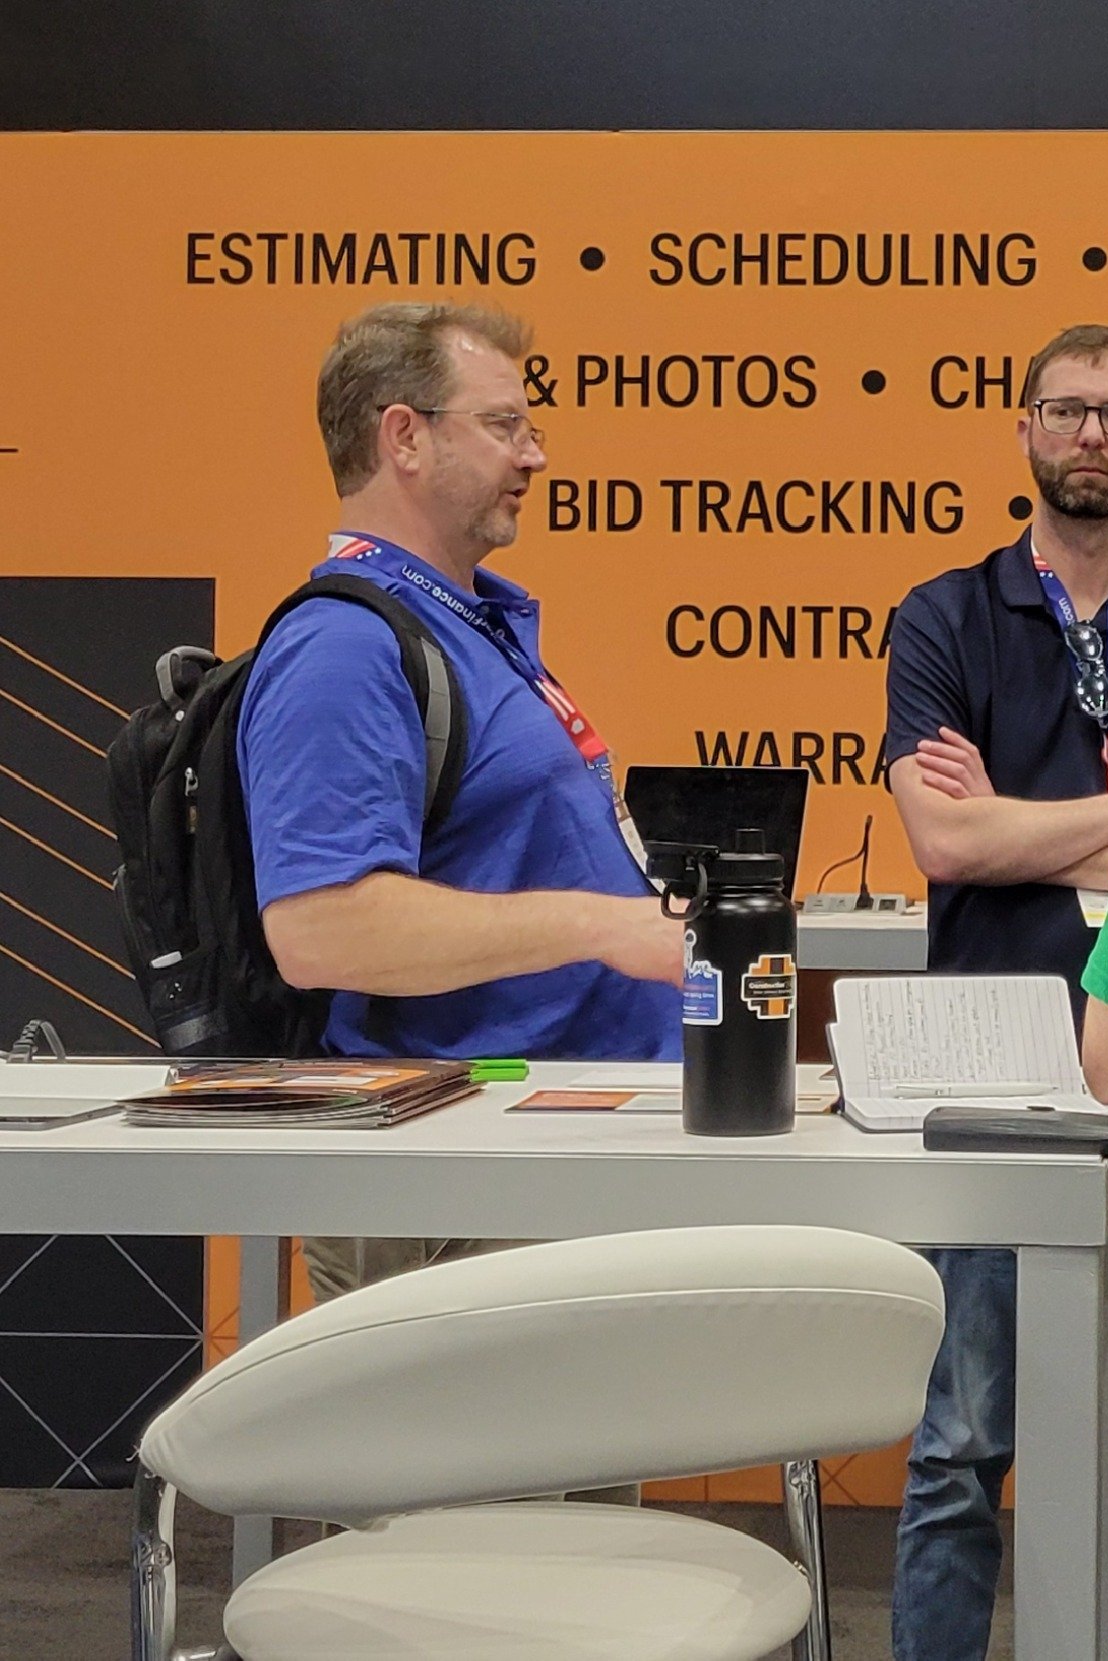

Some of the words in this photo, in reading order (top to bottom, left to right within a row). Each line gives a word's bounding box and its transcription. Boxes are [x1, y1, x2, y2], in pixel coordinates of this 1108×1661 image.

[187, 232, 536, 286] ESTIMATING
[650, 232, 1036, 287] SCHEDULING
[578, 354, 817, 409] PHOTOS
[549, 479, 643, 532] BID
[661, 479, 964, 535] TRACKING
